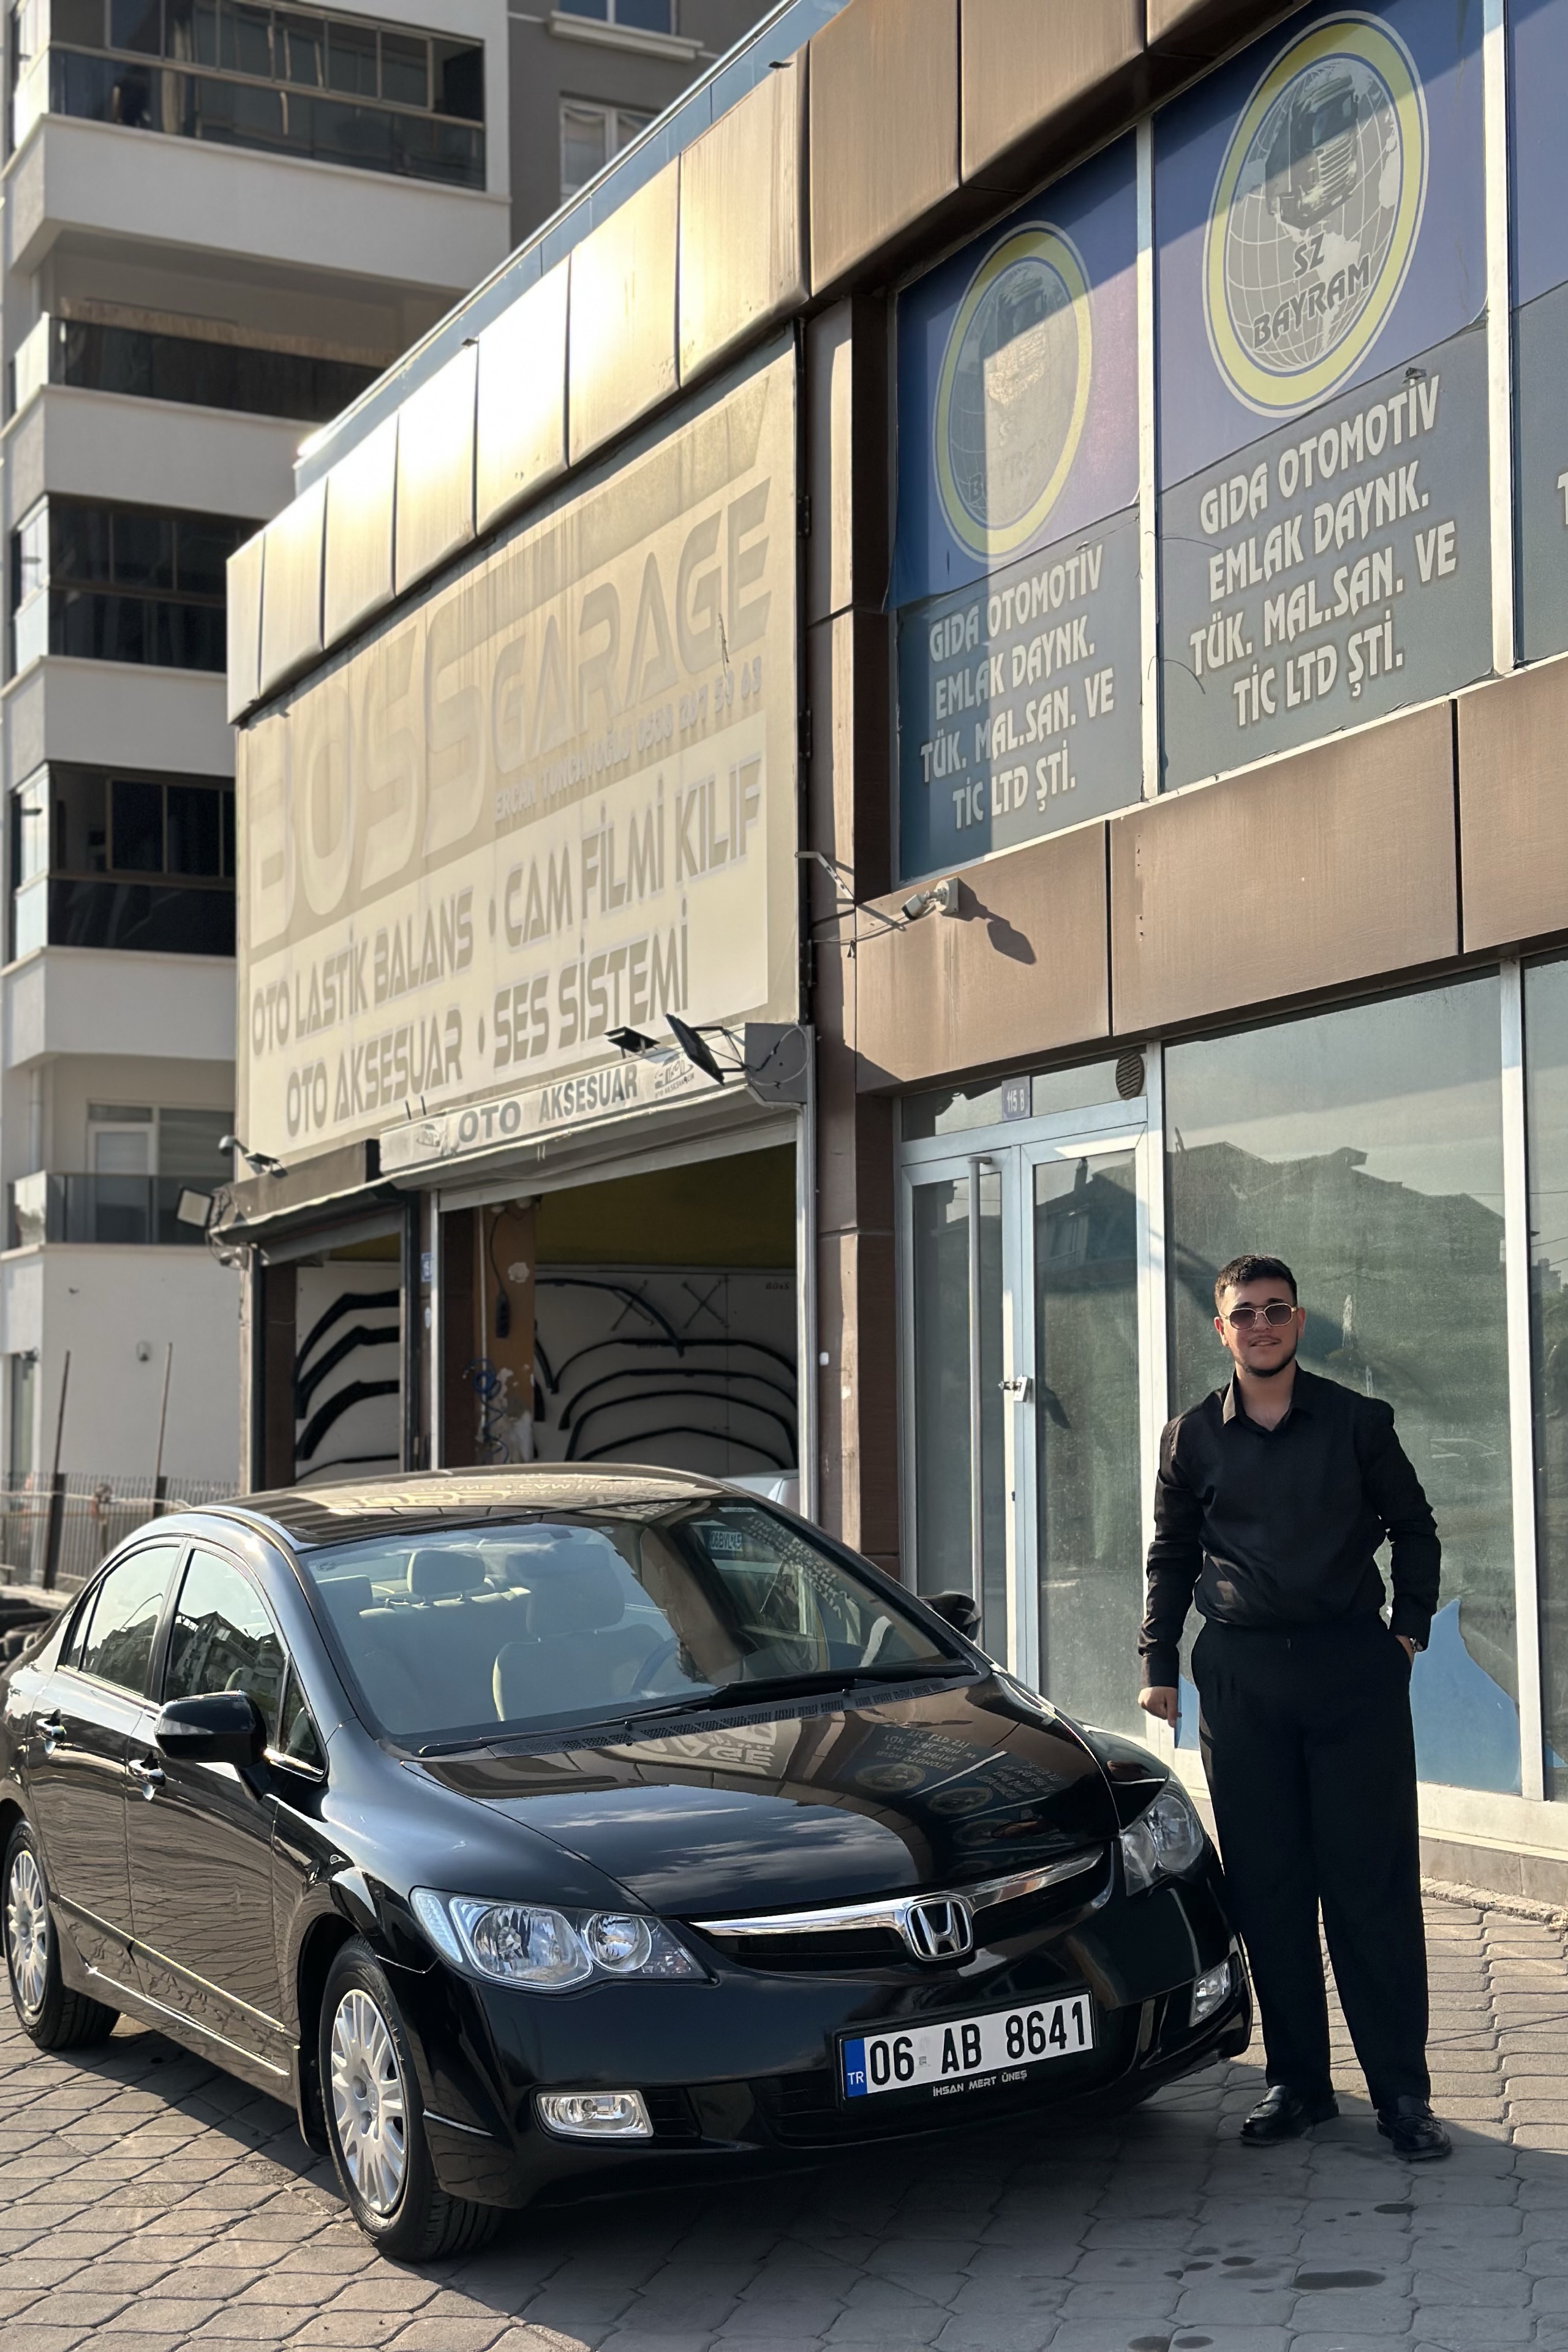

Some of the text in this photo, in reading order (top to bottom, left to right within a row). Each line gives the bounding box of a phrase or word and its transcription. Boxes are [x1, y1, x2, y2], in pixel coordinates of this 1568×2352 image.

[1254, 254, 1370, 347] BAYRAM
[1294, 233, 1325, 278] SZ
[1200, 375, 1439, 534] GIDA OTOMOTİV
[1209, 461, 1428, 603] EMLAK DAYNK.
[930, 545, 1102, 662] GIDA OTOMOTİV
[1190, 521, 1457, 676] TÜK. MAL.SAN. VE
[250, 476, 772, 948] BOSS GARAGE
[936, 615, 1095, 720] EMLAK DAYNK.
[1234, 610, 1403, 726] TİC LTD ŞTİ.
[921, 668, 1114, 783] TÜK. MAL.SAN. VE
[953, 740, 1076, 829] TİC LTD ŞTİ.
[252, 757, 762, 1057] OTO LASTİK BALANS CAM FİLMİ KILIF
[287, 897, 688, 1138] OTO AKSESUAR SES SİSTEMİ
[459, 1065, 638, 1143] OTO AKSESUAR
[847, 2001, 1084, 2086] TR 06 AB 8641
[933, 2070, 1027, 2097] İHSAN MERT ÜNEŞ
